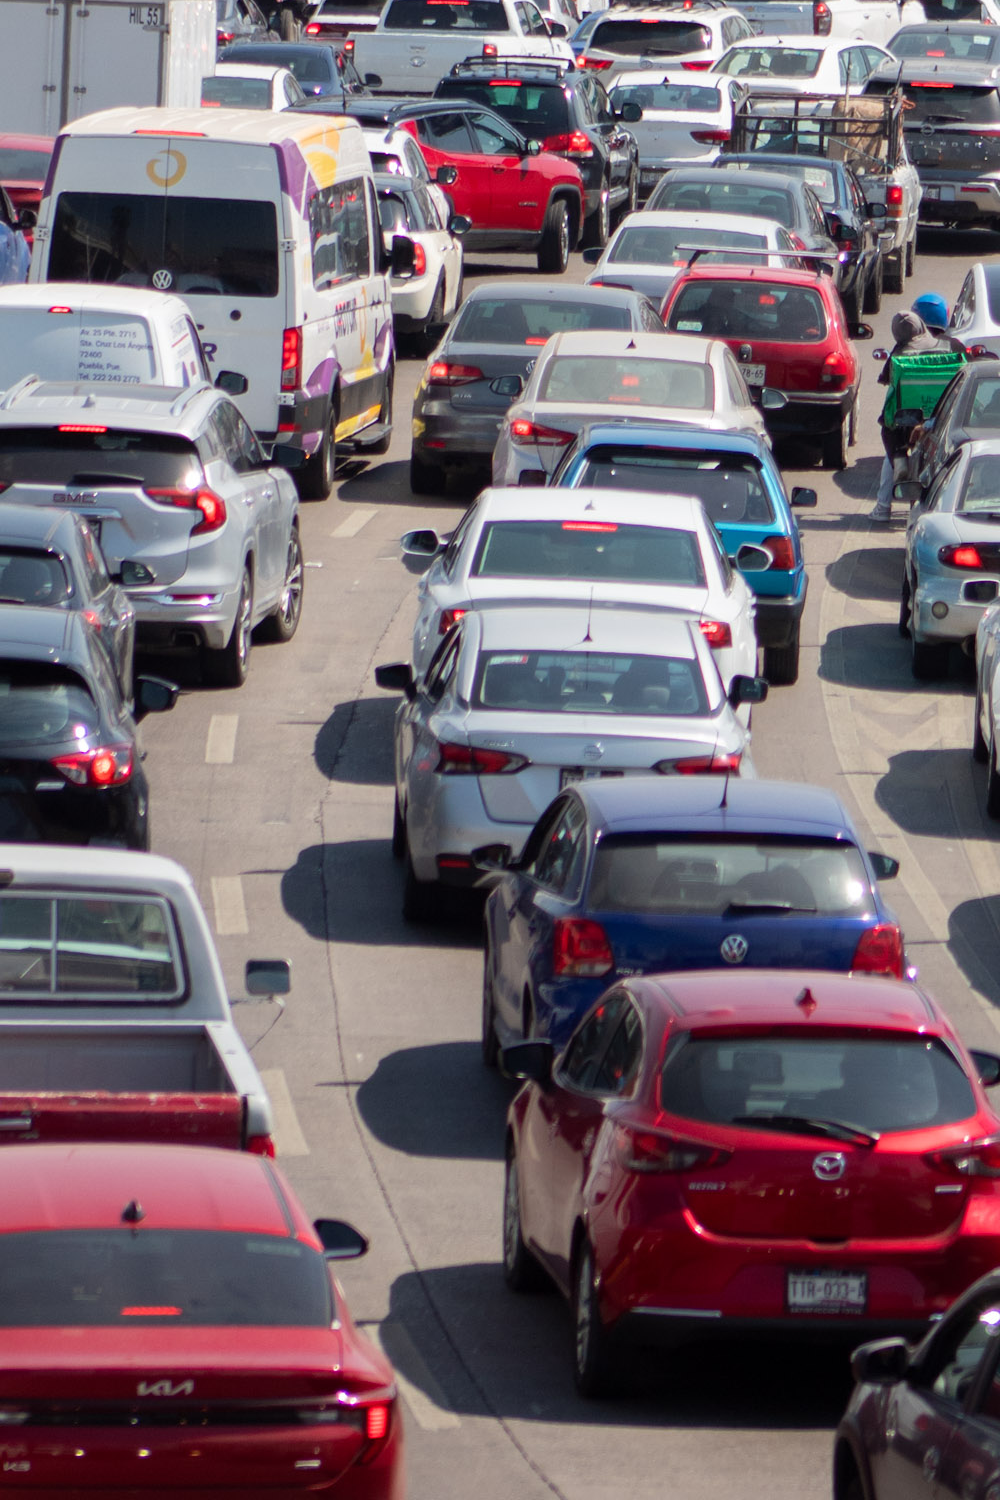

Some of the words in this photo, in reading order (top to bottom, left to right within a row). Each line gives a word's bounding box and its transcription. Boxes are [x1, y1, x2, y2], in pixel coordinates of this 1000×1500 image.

[129, 6, 144, 24] HIL
[147, 7, 158, 25] 55
[53, 491, 98, 503] GMC
